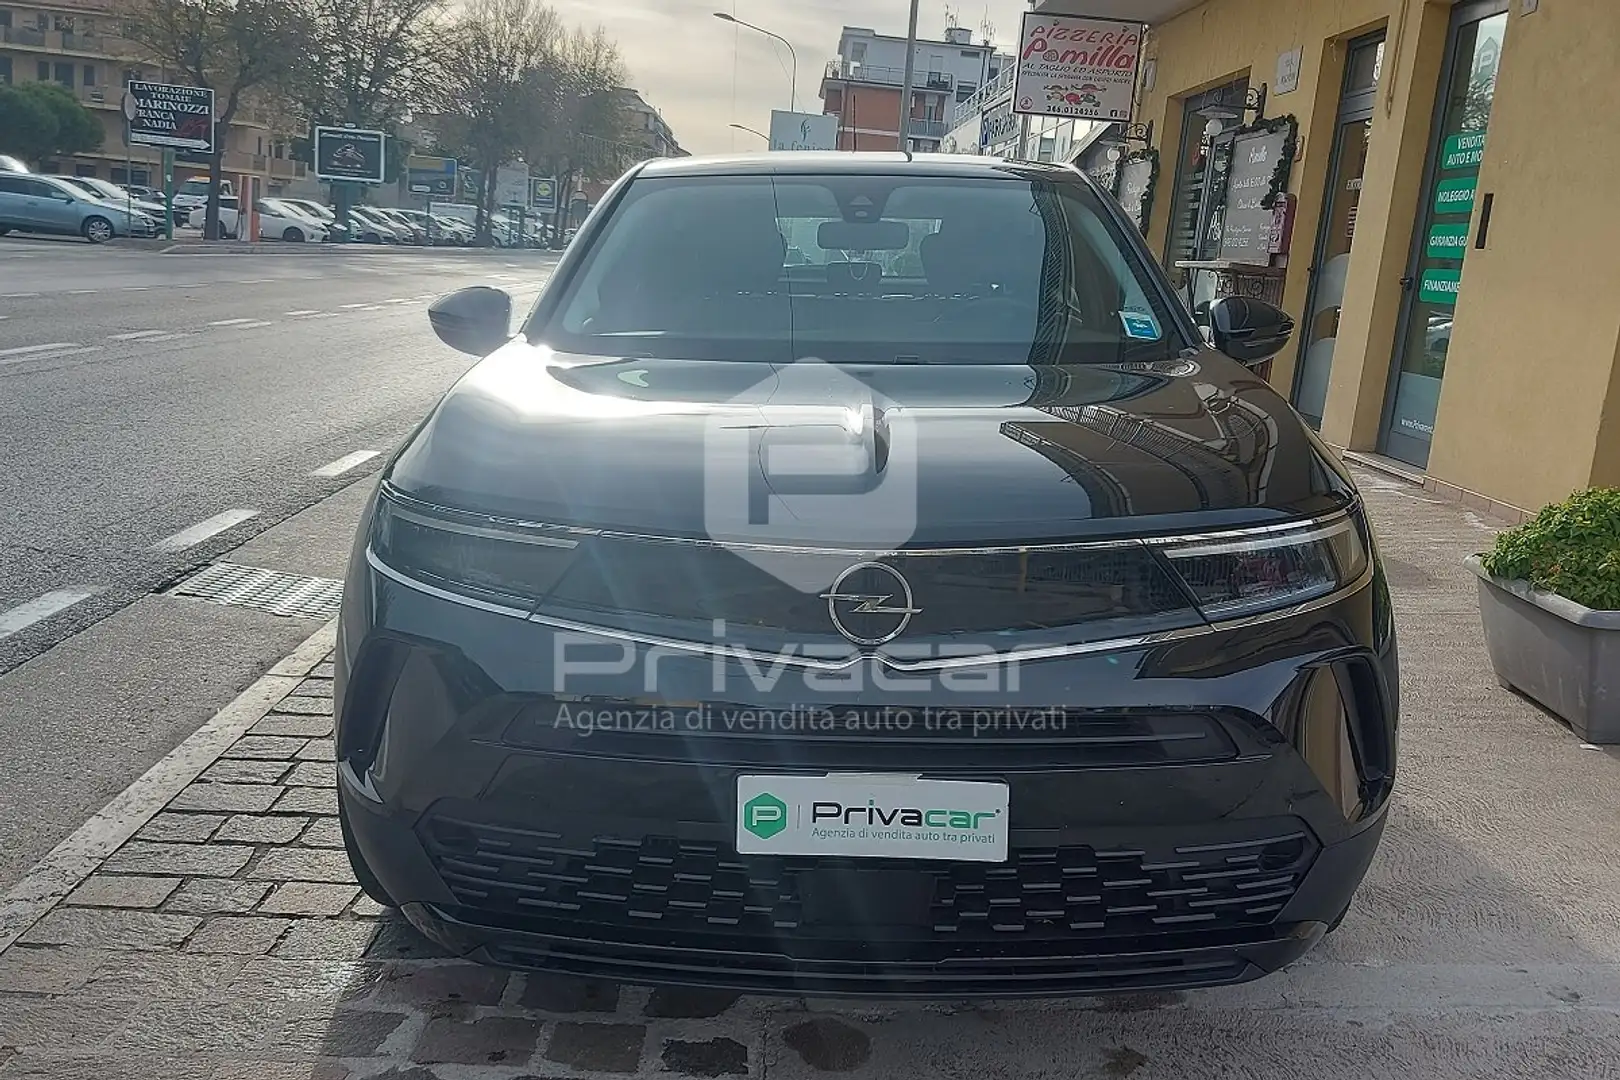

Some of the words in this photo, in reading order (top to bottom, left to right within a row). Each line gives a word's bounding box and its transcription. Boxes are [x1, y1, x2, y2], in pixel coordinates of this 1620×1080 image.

[134, 83, 207, 98] LAVORAZIONE
[142, 119, 177, 130] NADIA
[1446, 152, 1466, 166] AUTO
[1437, 189, 1470, 203] NOLEGGIO
[811, 828, 855, 840] Agenzia
[858, 828, 869, 838] di
[871, 829, 912, 840] vendita
[914, 831, 940, 841] auto
[942, 832, 957, 842] tra
[960, 832, 995, 844] privati
